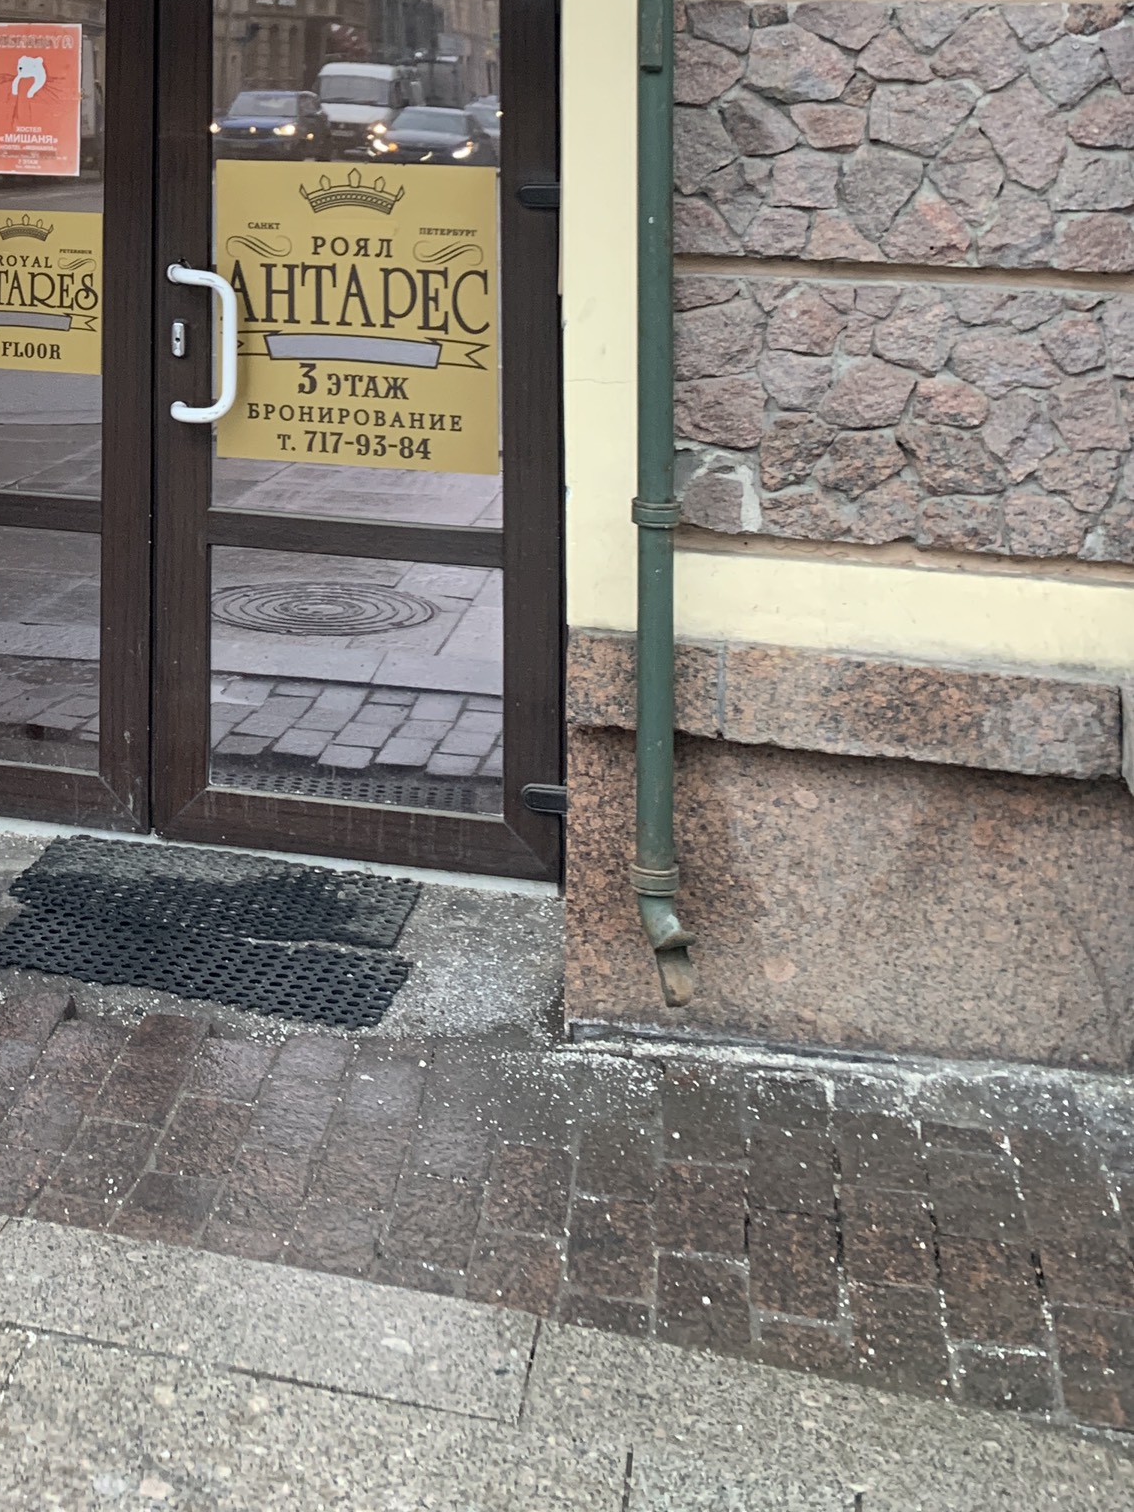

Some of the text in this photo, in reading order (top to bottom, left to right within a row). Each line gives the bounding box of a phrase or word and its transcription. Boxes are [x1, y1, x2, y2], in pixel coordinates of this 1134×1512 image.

[247, 221, 478, 237] САНКТ ПЕТЕРБУРГ
[311, 236, 393, 258] РОЯЛ
[220, 259, 490, 335] АНТАРЕС
[1, 341, 62, 360] FLOOR
[297, 362, 409, 400] 3 ЭТАЖ
[247, 402, 463, 432] БРОНИРОВАНИЕ
[303, 430, 432, 460] 717-93-84
